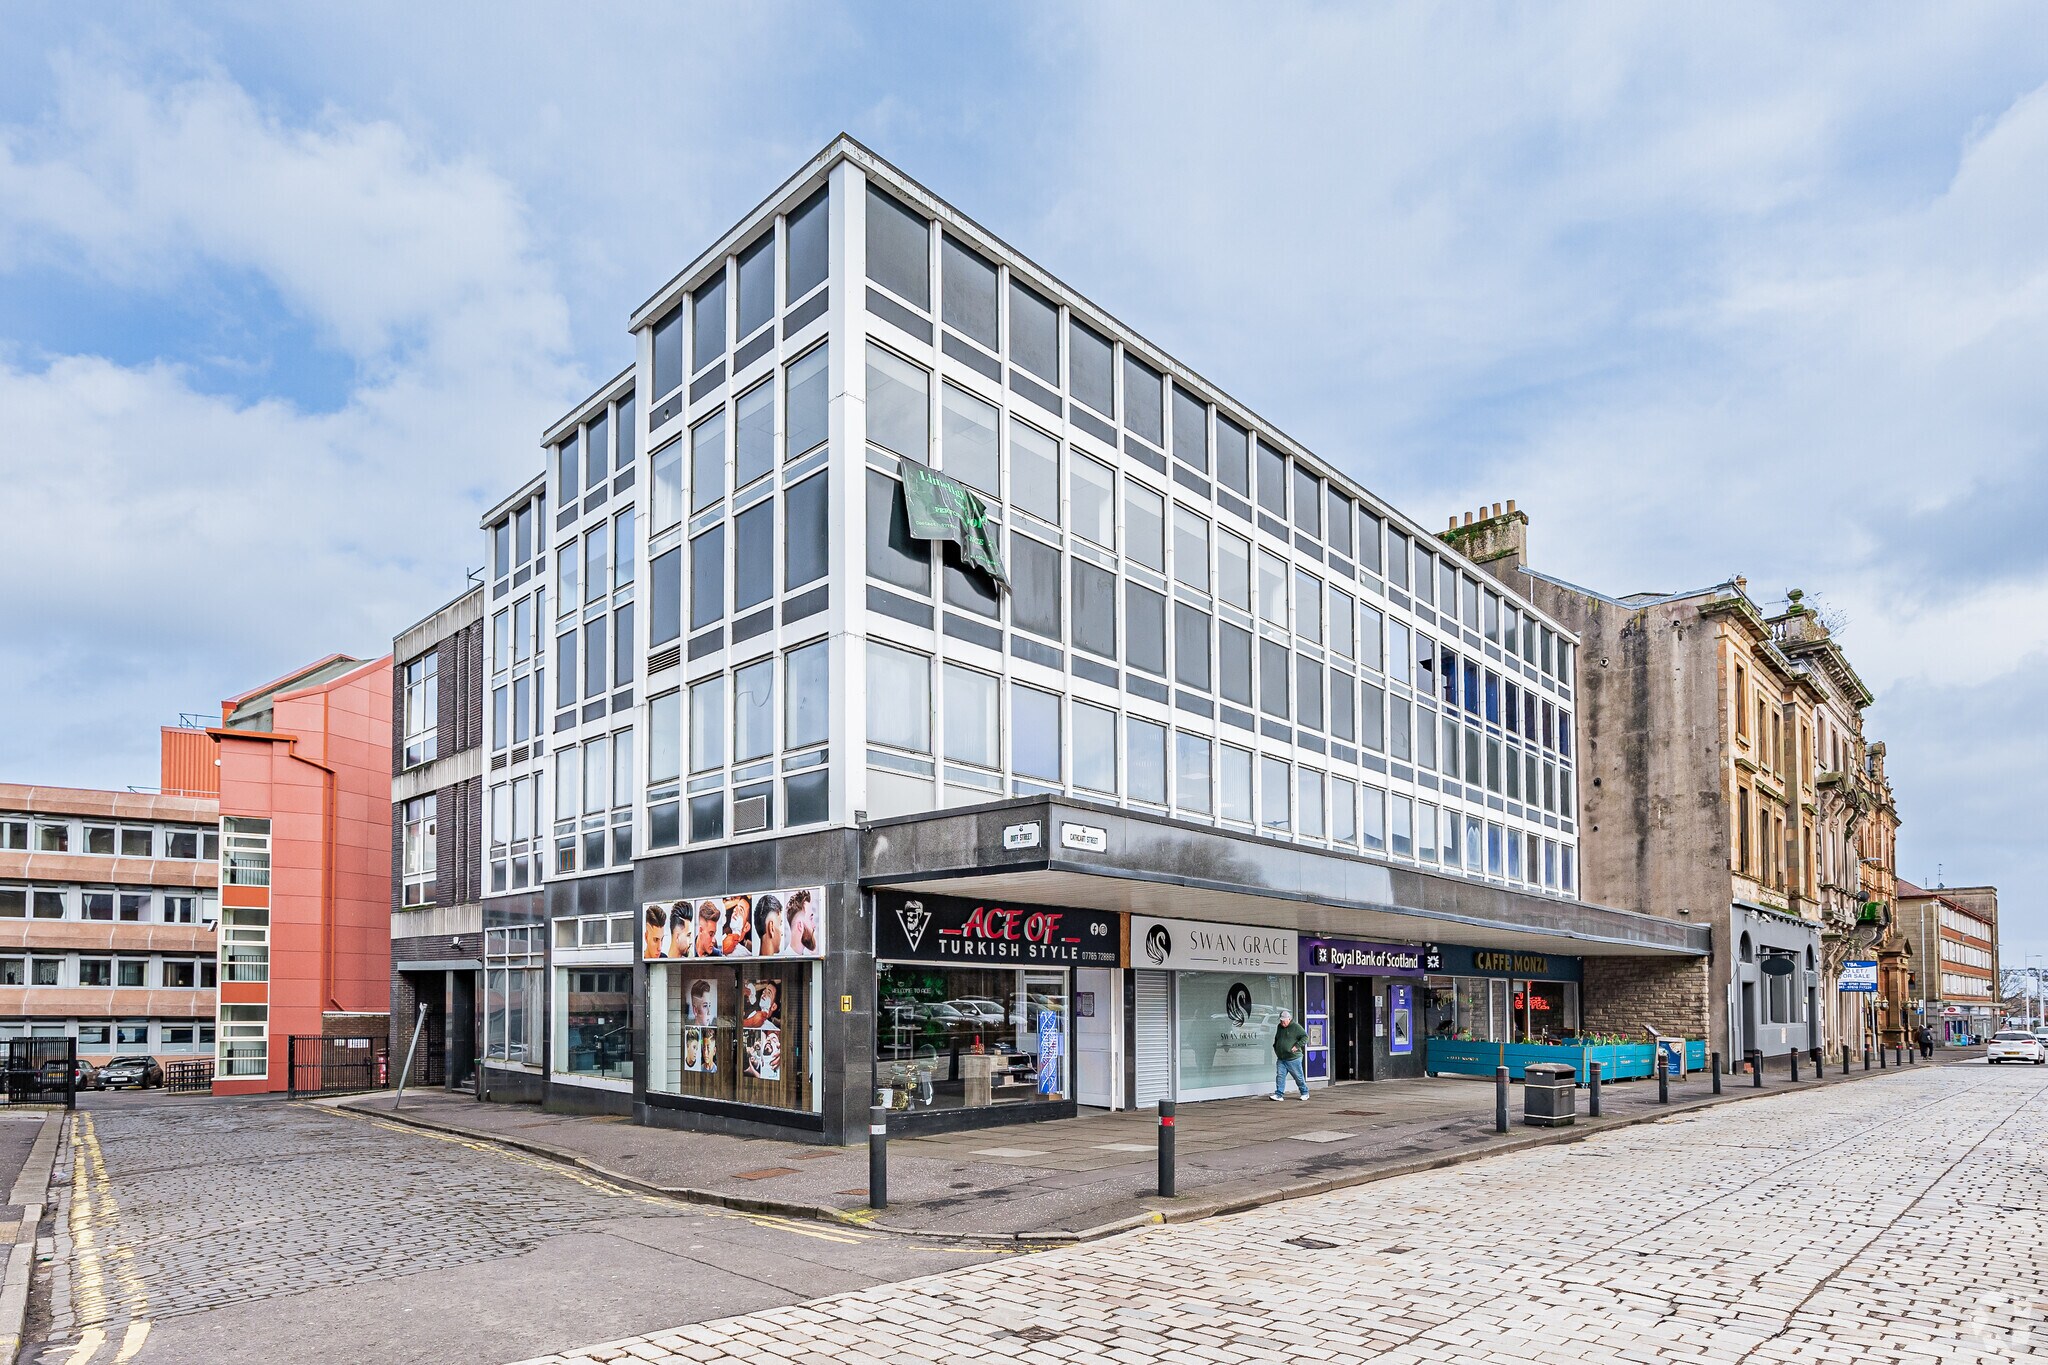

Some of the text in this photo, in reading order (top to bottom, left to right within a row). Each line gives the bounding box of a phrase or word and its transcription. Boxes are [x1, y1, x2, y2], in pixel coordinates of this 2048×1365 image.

[1019, 833, 1033, 841] STREET
[1086, 836, 1099, 845] STREET
[962, 906, 1063, 945] ACE OF
[938, 939, 1078, 960] TURKISH STYLE
[1190, 930, 1288, 956] SWAN GRACE
[1222, 956, 1260, 966] PILATES
[1331, 948, 1418, 969] Royal Bank of Scotland
[1477, 952, 1549, 973] CAFFE MONZA
[842, 996, 851, 1010] H
[1220, 1032, 1257, 1040] SWAN GRACE
